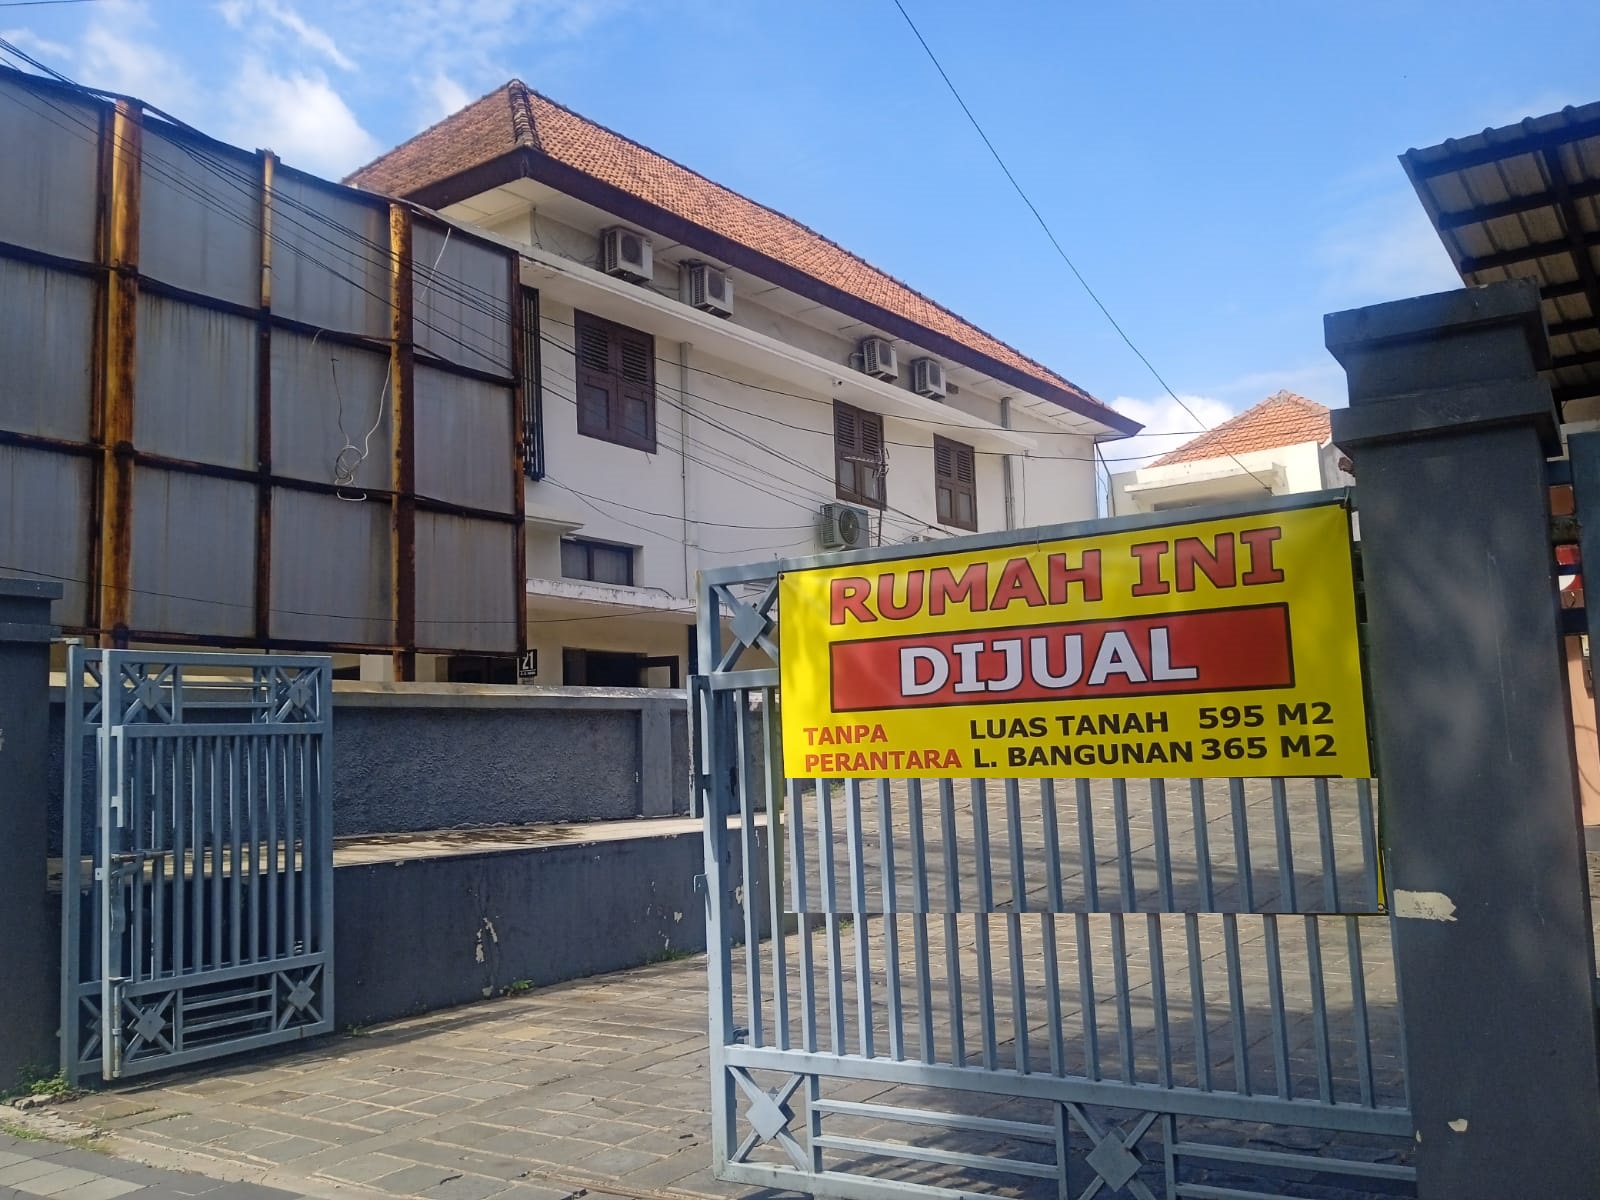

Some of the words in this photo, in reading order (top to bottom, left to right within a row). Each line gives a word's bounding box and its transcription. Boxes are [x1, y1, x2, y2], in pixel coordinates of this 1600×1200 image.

[829, 548, 1103, 625] RUMAH
[1131, 526, 1284, 597] INI
[522, 651, 534, 670] 21
[899, 626, 1199, 697] DIJUAL
[803, 724, 888, 746] TANPA
[970, 715, 1048, 740] LUAS
[1055, 712, 1168, 736] TANAH
[1199, 705, 1264, 729] 595
[1277, 702, 1334, 726] M2
[805, 748, 962, 773] PERANTARA
[974, 747, 997, 768] L.
[1007, 741, 1193, 767] BANGUNAN
[1201, 736, 1268, 760] 365
[1281, 733, 1337, 758] M2
